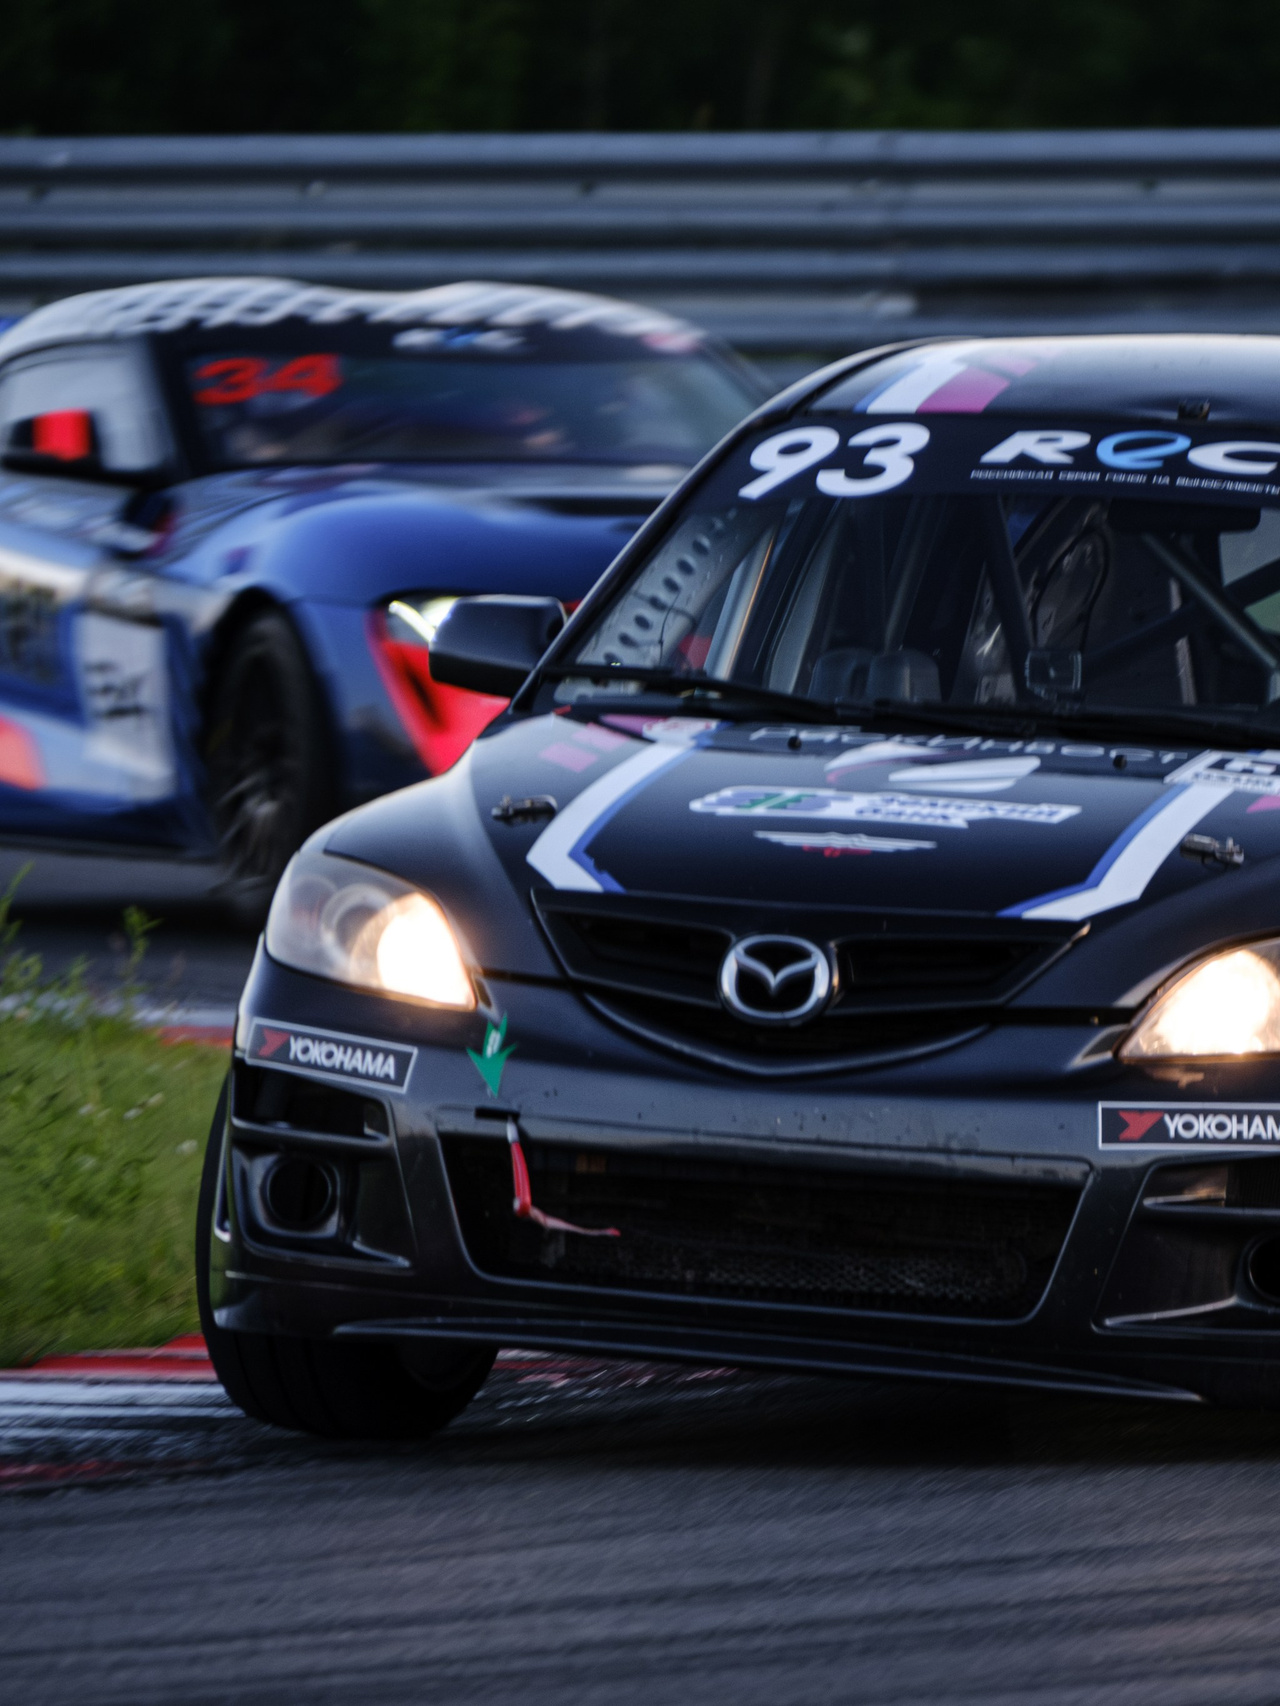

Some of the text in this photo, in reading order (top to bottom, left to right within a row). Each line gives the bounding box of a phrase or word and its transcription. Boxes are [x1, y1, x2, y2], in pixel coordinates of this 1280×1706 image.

[193, 352, 342, 406] 34
[738, 422, 931, 499] 93
[289, 1034, 396, 1080] YOKOHAMA
